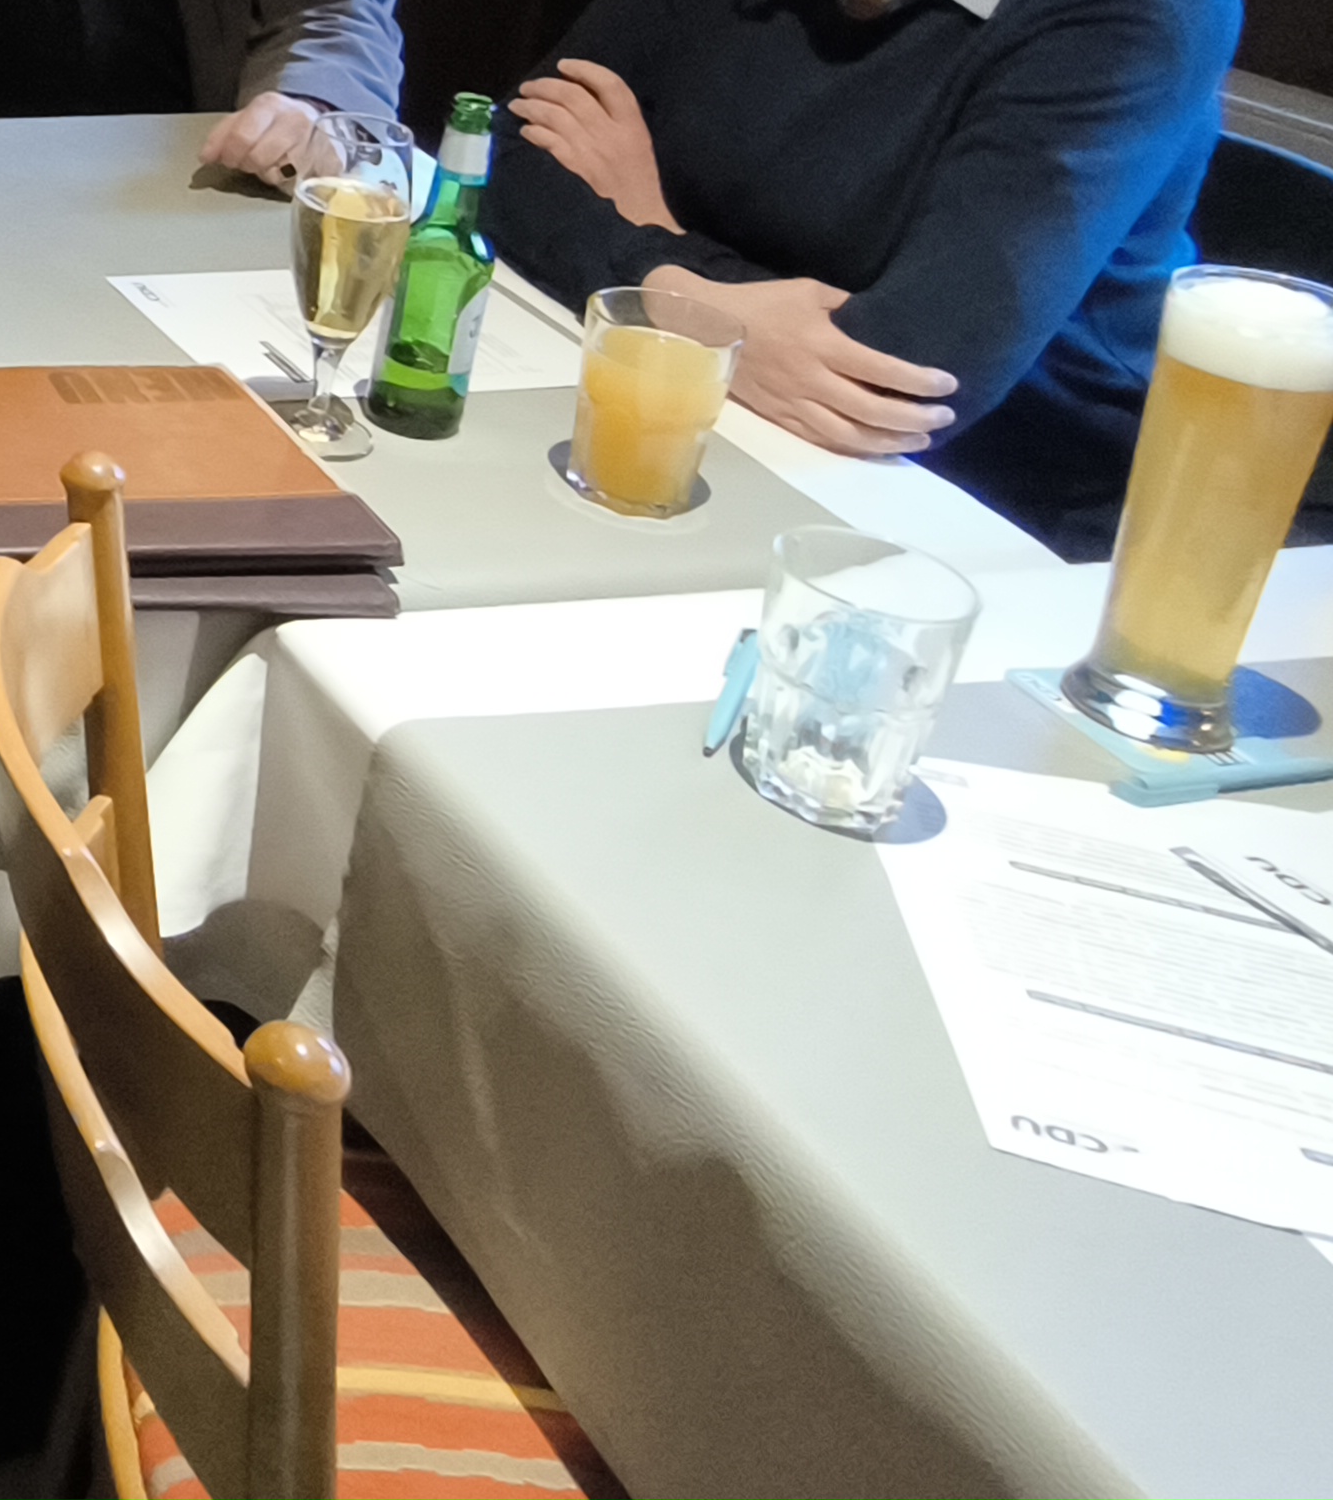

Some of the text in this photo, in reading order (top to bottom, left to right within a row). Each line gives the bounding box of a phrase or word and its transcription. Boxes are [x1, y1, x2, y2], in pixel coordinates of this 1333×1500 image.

[47, 371, 243, 404] MENU
[1244, 856, 1332, 905] CDU
[1011, 1115, 1109, 1154] CDU
